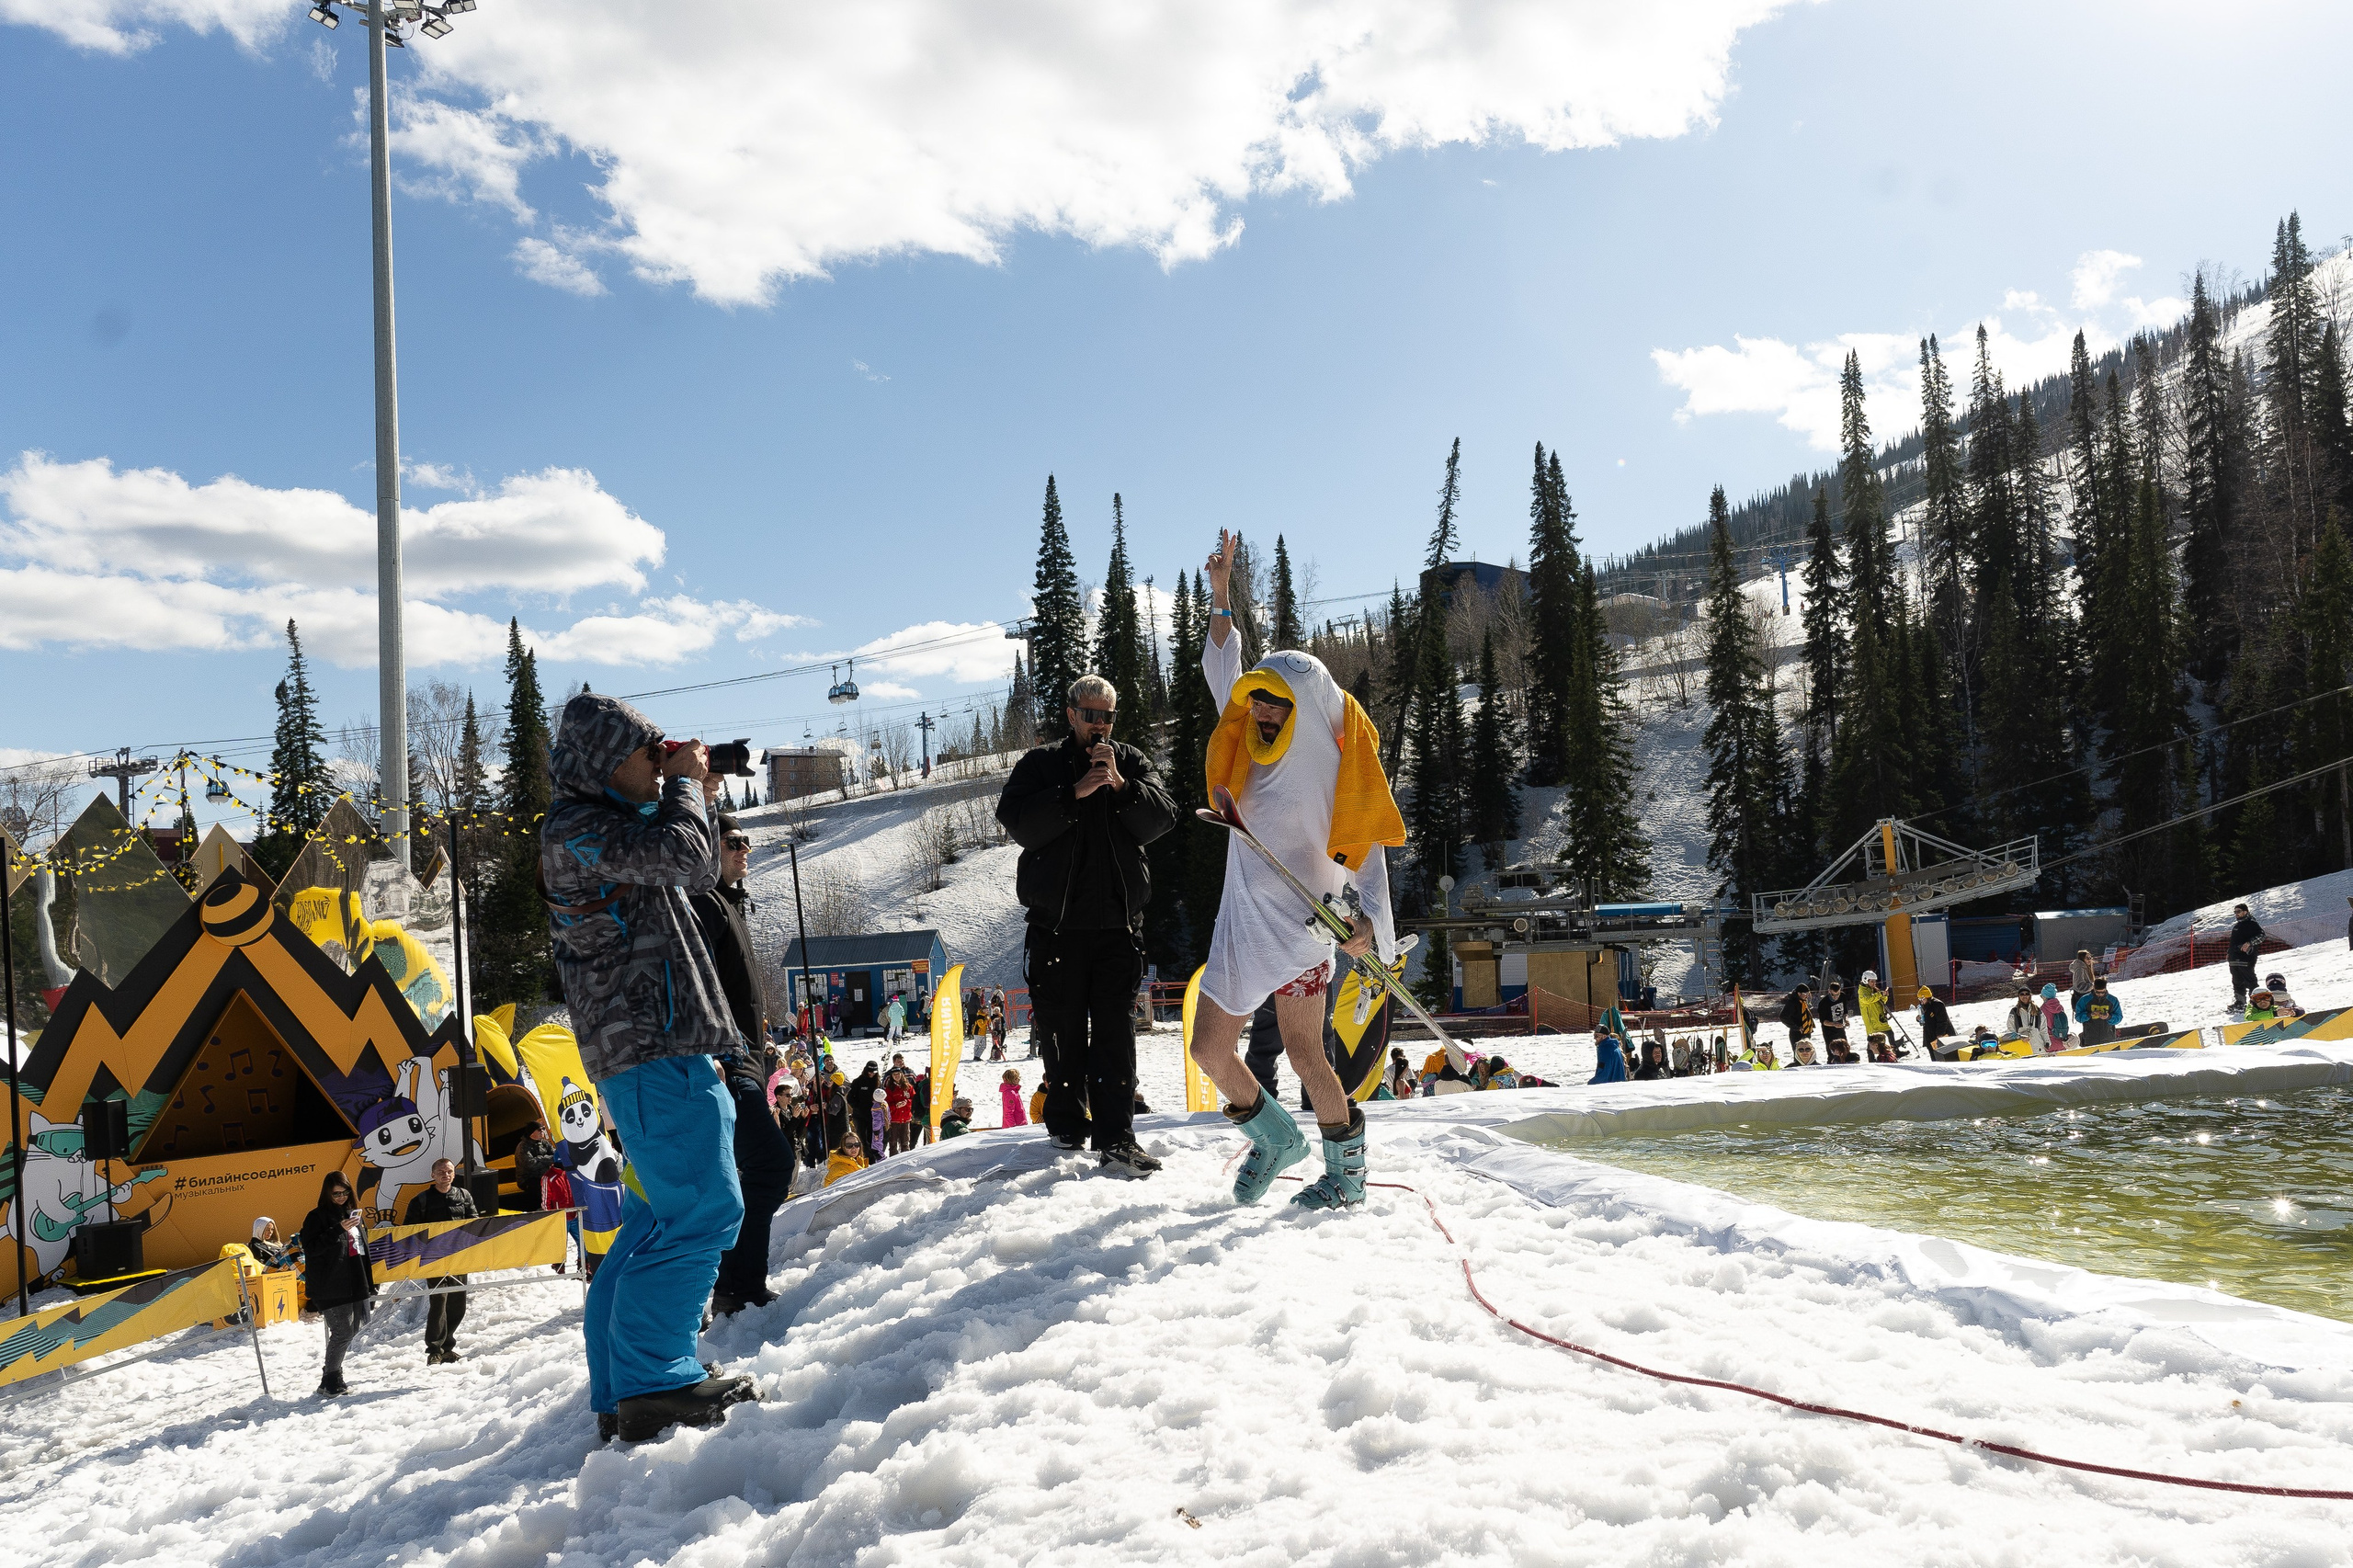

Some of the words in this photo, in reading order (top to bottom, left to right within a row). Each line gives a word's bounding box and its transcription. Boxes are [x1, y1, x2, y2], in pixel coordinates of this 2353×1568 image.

[931, 996, 952, 1106] РЕГИСТРАЦИЯ
[174, 1164, 316, 1191] #билайнсоединяет
[174, 1184, 245, 1201] музыкальных
